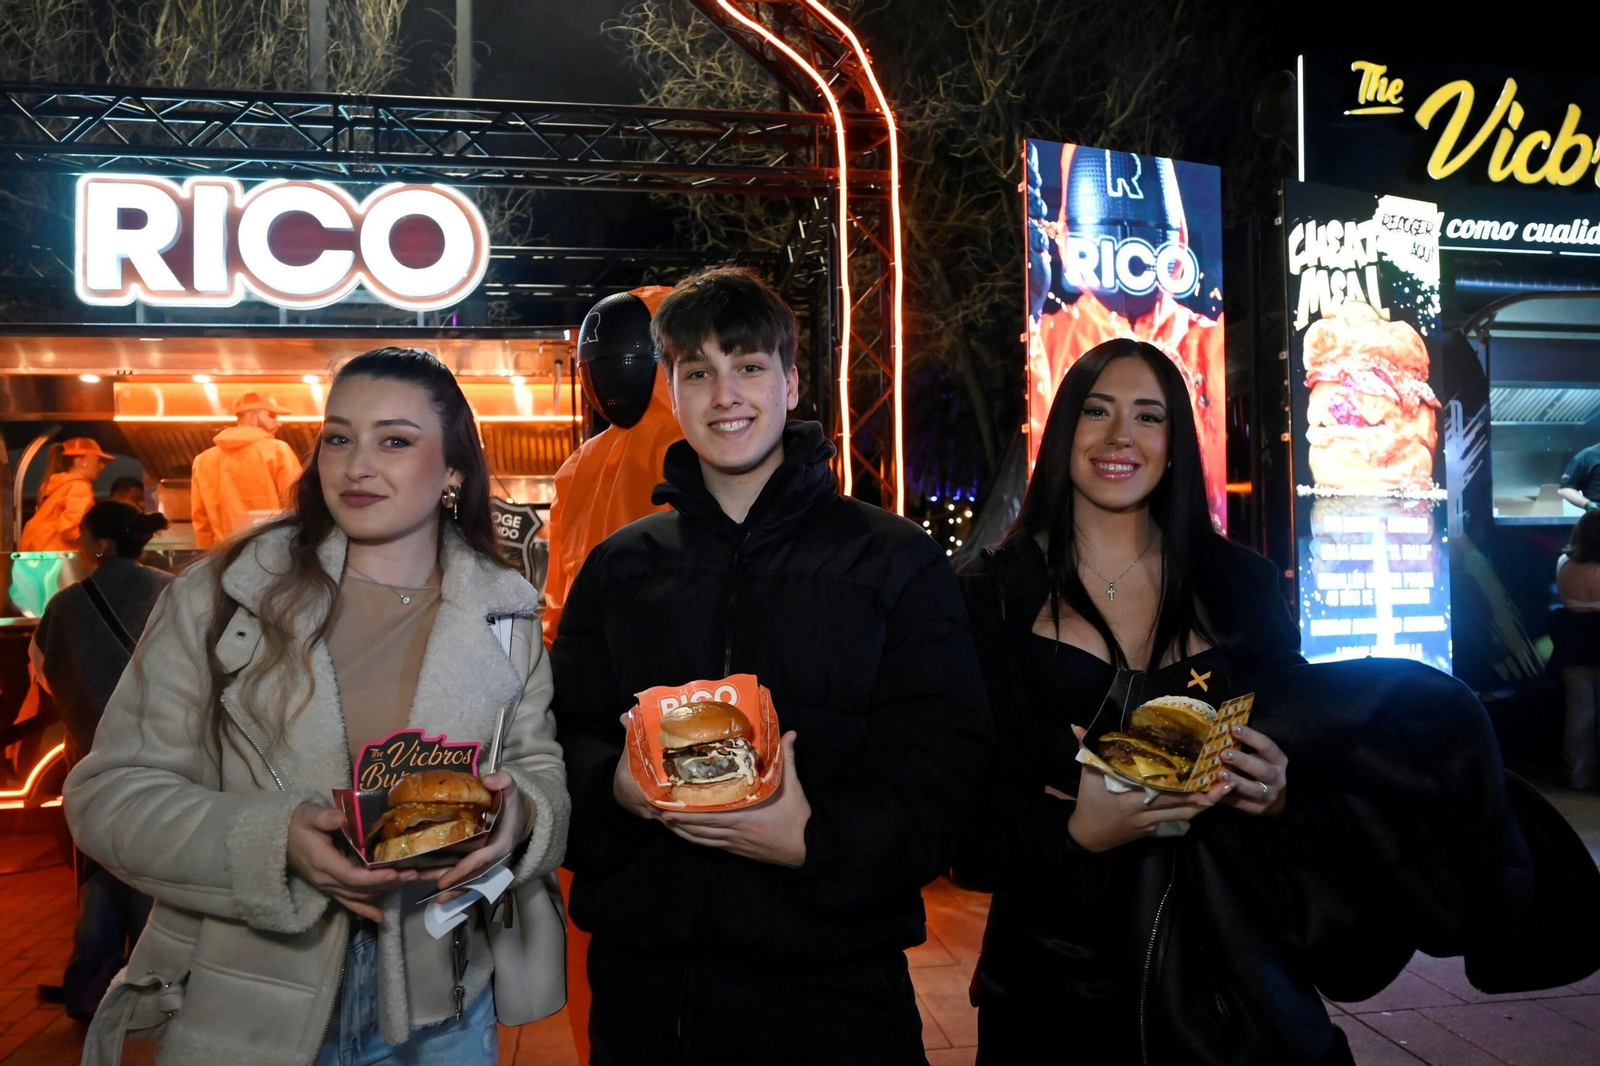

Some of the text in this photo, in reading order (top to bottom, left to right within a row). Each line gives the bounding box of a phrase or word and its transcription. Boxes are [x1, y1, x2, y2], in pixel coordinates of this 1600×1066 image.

[1350, 60, 1600, 187] The Vicb
[1105, 149, 1144, 199] R
[84, 180, 476, 299] RICO
[1288, 219, 1379, 275] CHEAT
[1446, 218, 1519, 241] como
[1063, 236, 1198, 294] RICO
[1296, 265, 1391, 331] MEAL
[387, 739, 473, 768] Vicbros
